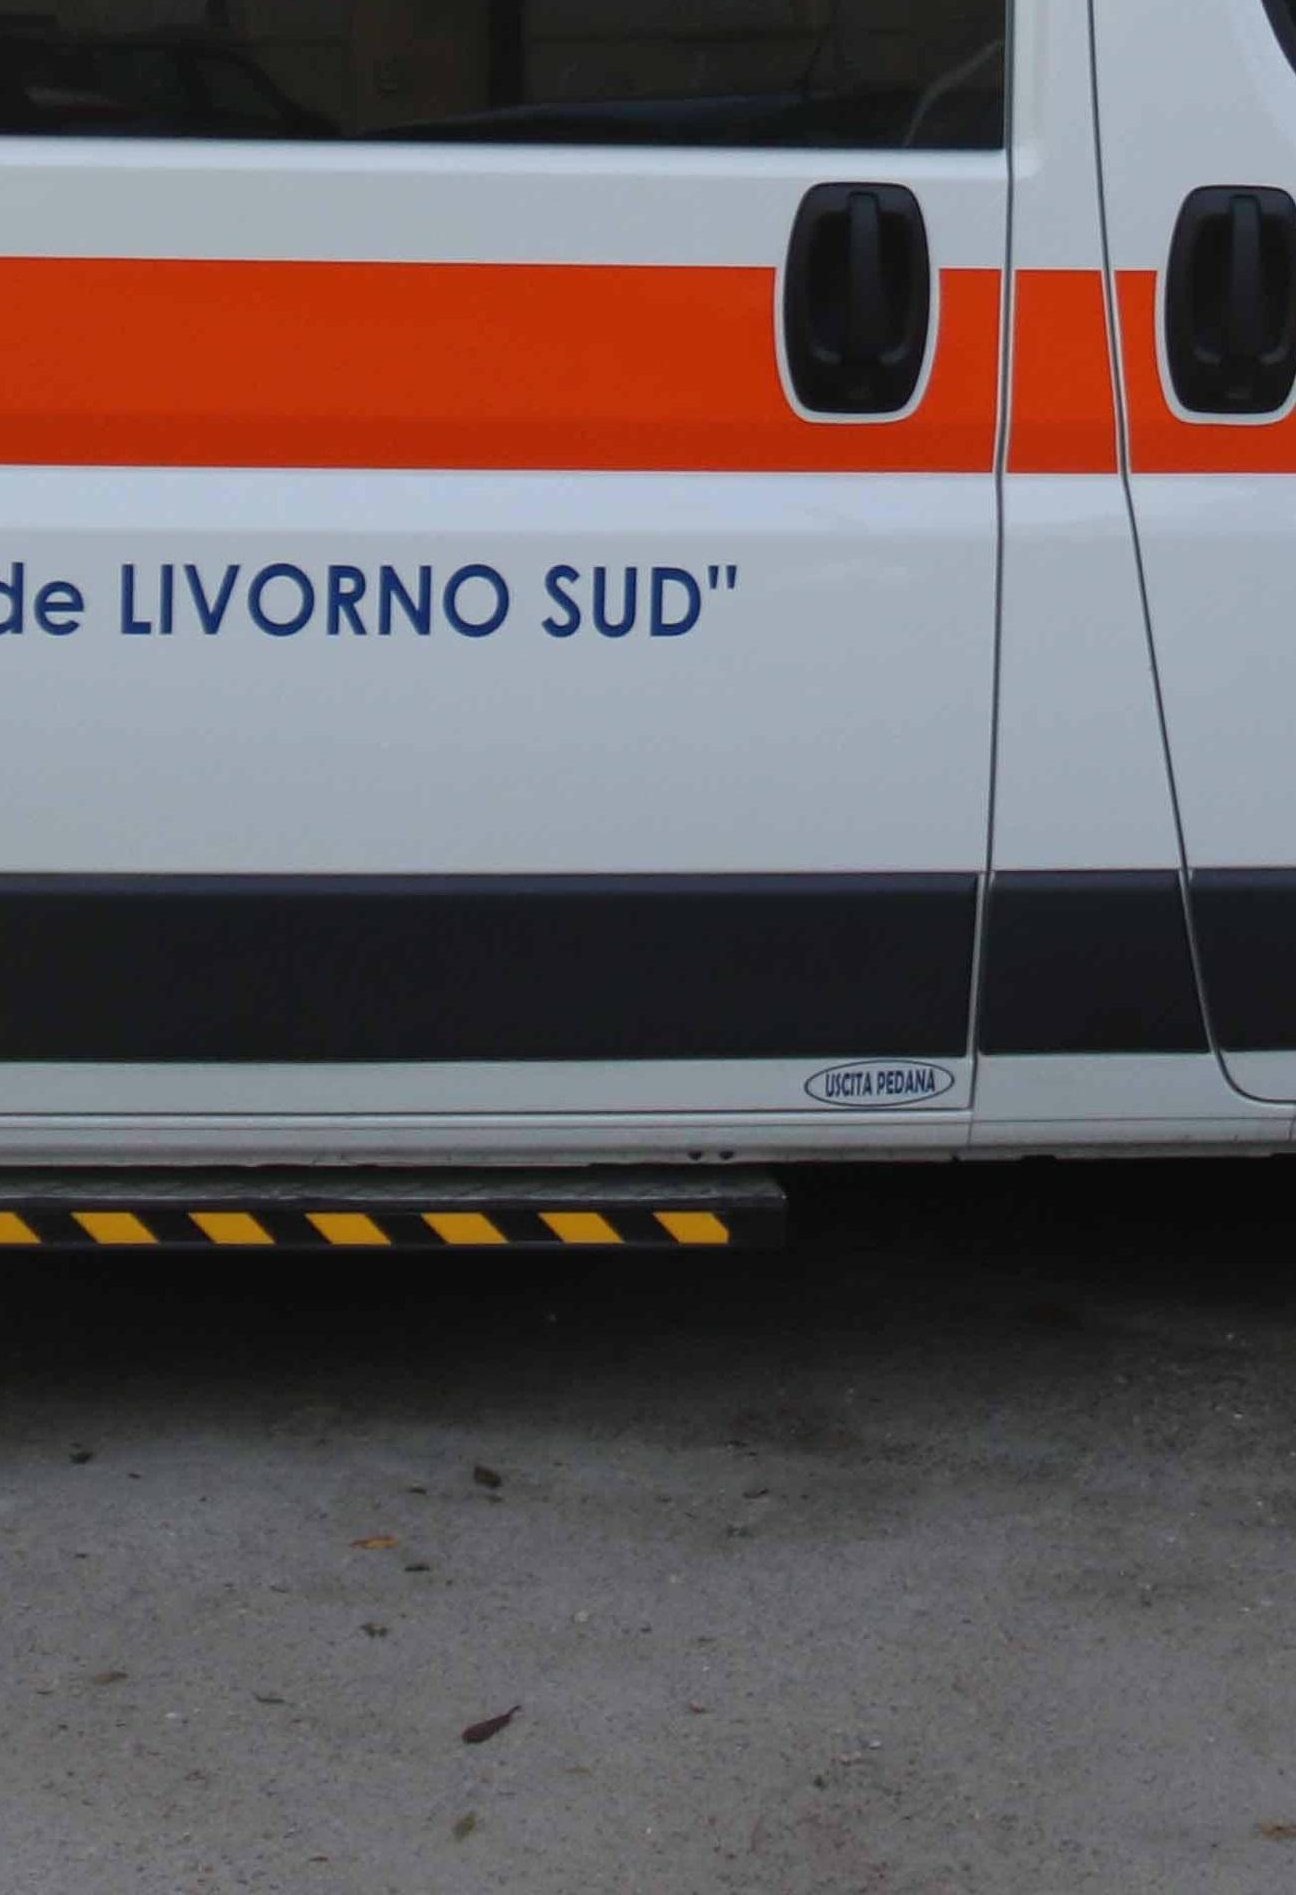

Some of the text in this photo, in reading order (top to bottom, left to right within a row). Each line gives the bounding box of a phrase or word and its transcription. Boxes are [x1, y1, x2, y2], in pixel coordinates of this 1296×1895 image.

[119, 562, 510, 638] LIVORNO
[825, 1068, 936, 1098] USCITA PEDANA
